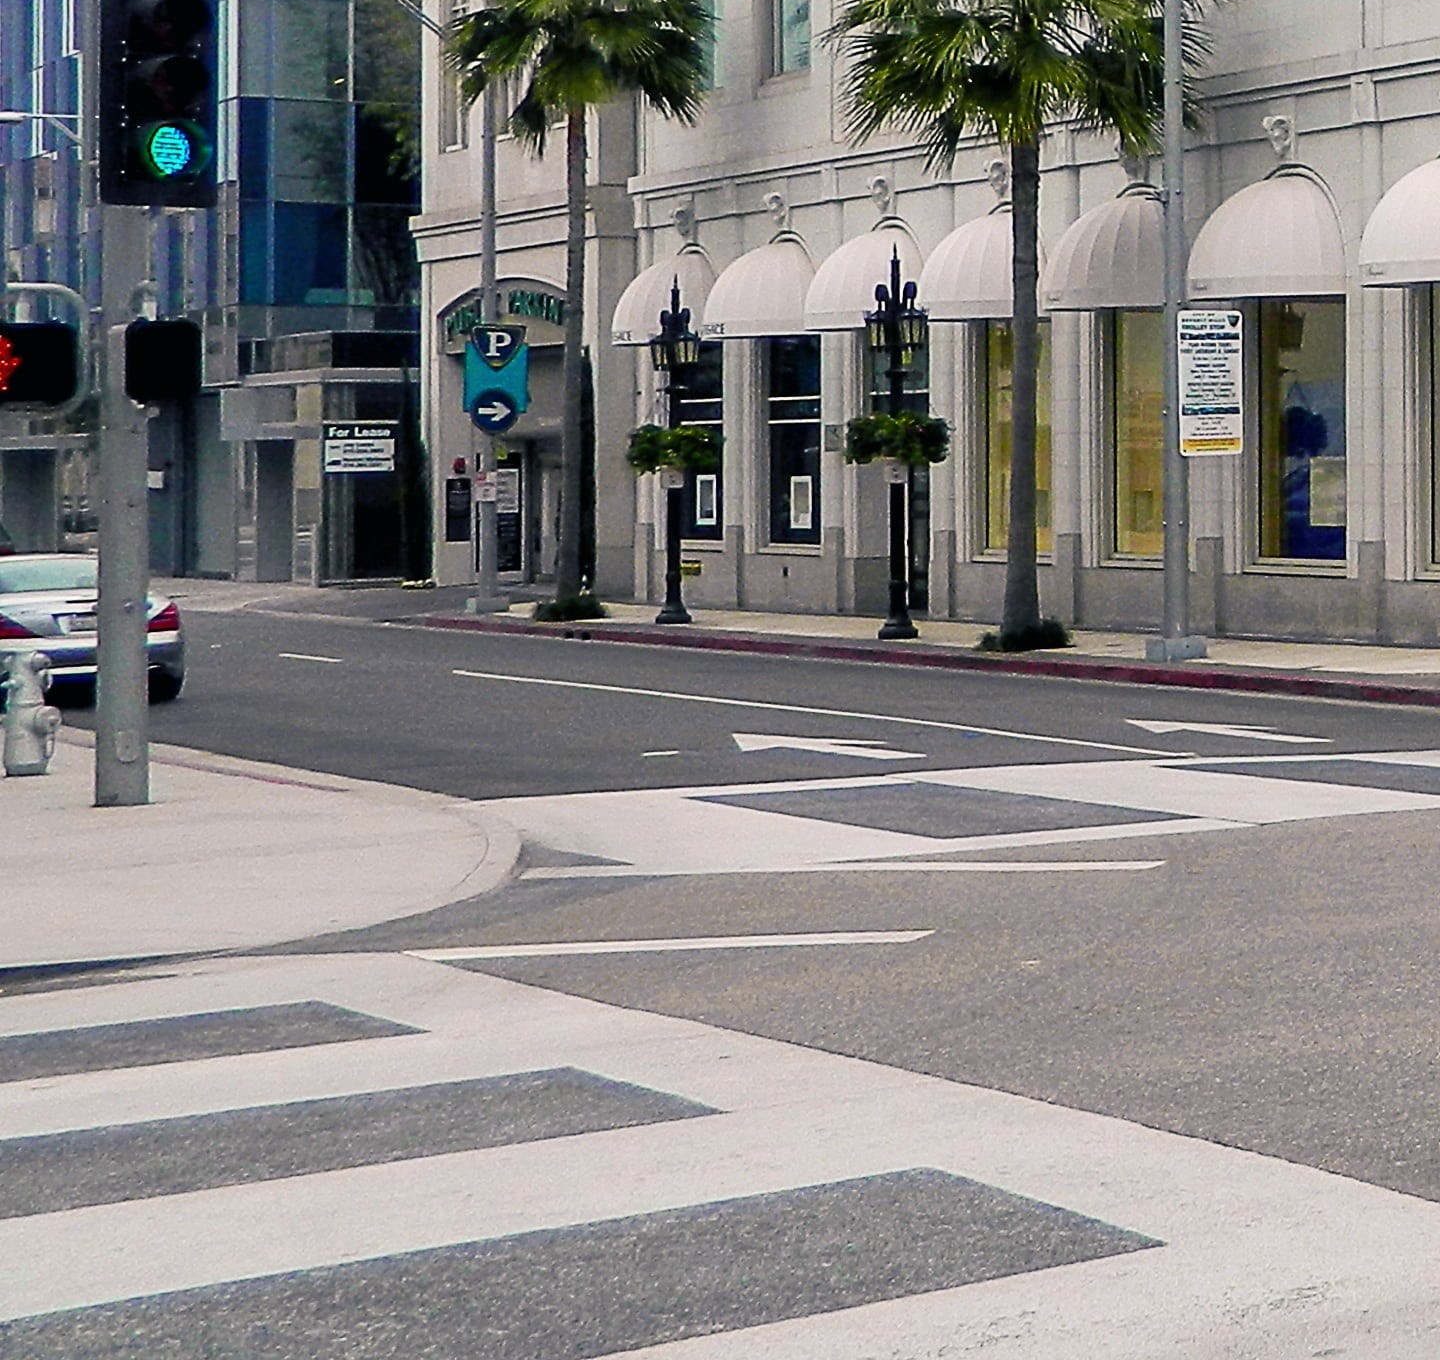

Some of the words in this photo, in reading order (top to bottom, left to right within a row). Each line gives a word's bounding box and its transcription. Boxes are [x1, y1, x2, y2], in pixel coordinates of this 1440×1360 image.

[507, 288, 567, 327] PARKIN
[485, 331, 512, 357] P
[328, 426, 350, 438] For
[354, 426, 391, 438] Lease
